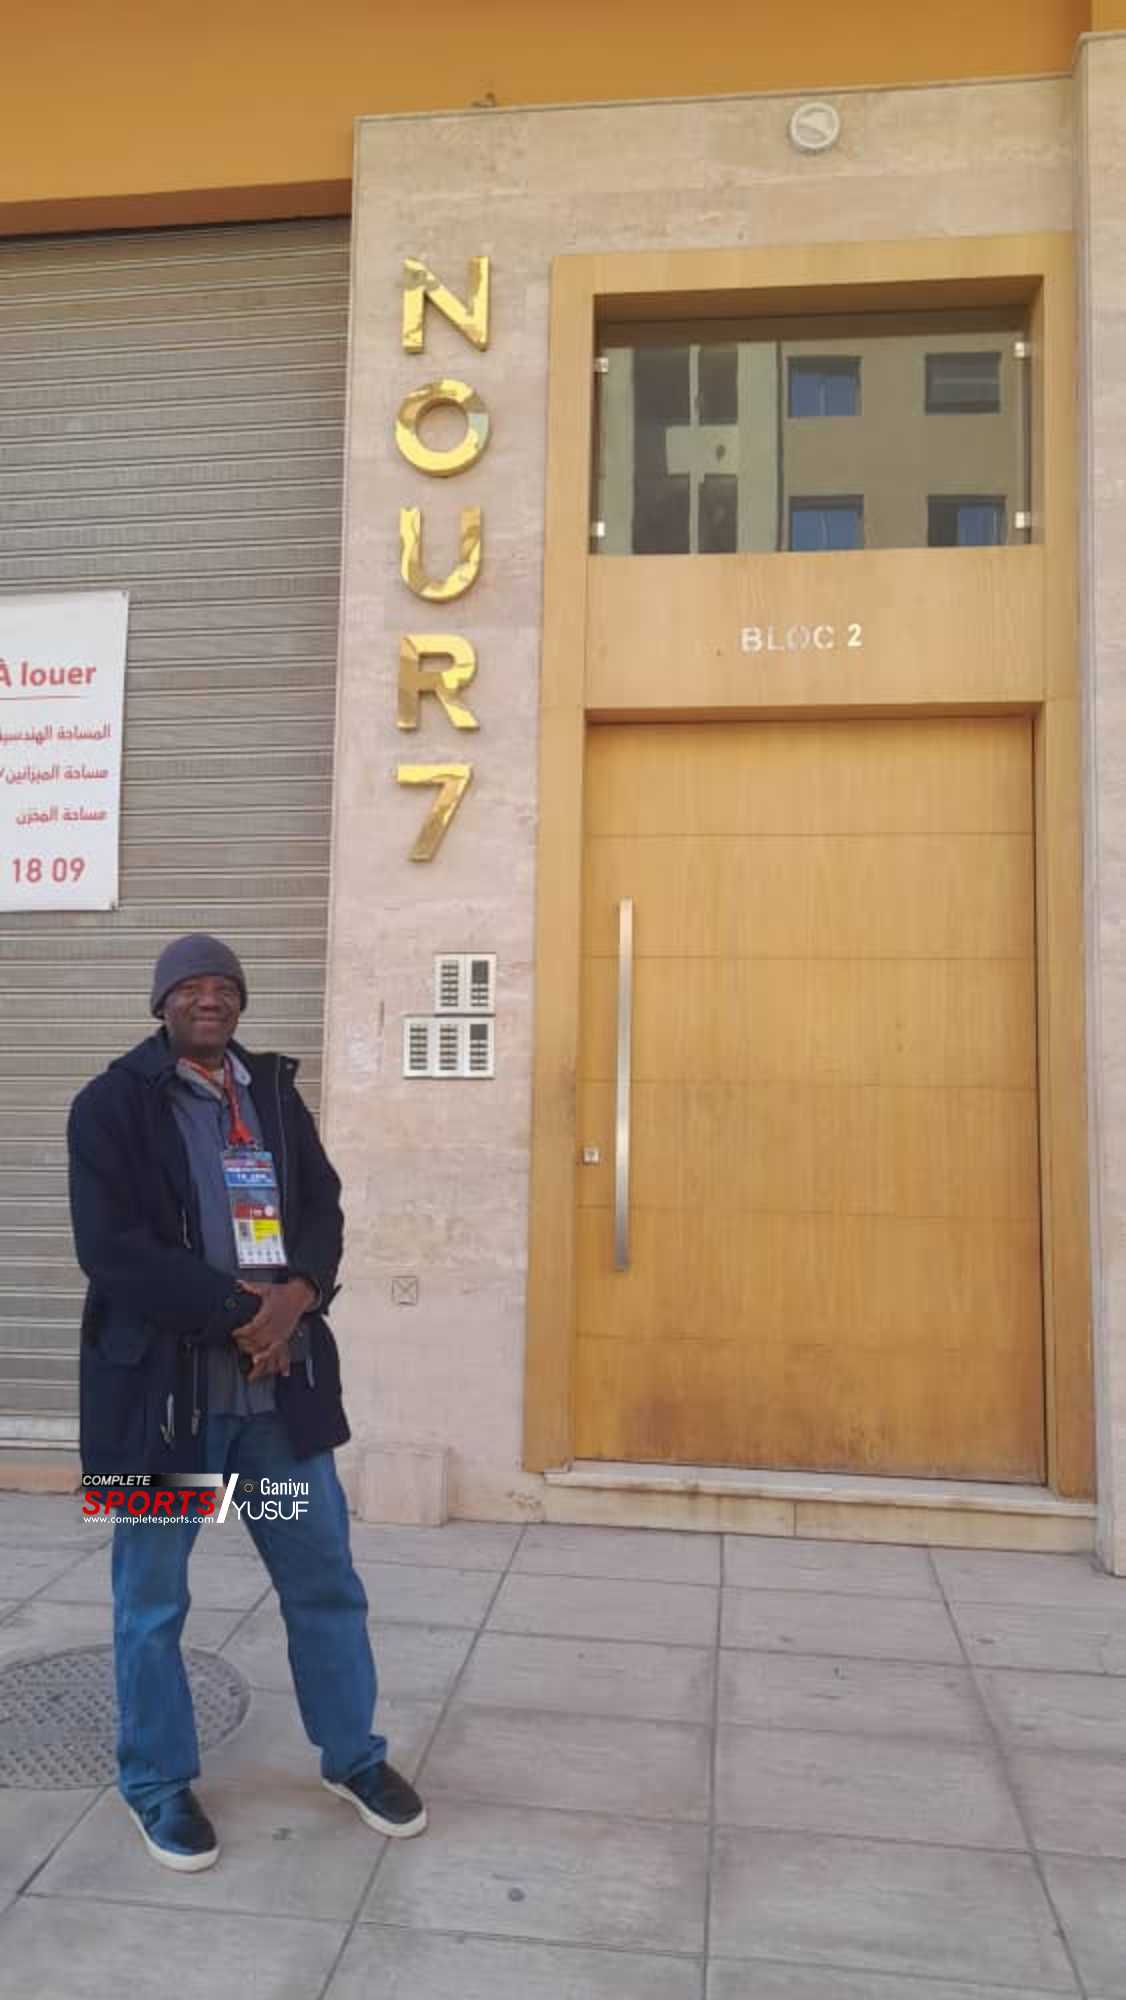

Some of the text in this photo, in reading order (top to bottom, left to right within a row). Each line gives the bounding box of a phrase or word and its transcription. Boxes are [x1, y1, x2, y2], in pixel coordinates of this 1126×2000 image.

[741, 623, 863, 653] BLOC 2
[21, 661, 97, 687] louer
[57, 723, 111, 742] المساحة
[63, 764, 109, 780] مساحة
[63, 805, 107, 821] مساحة
[12, 856, 85, 884] 18 09
